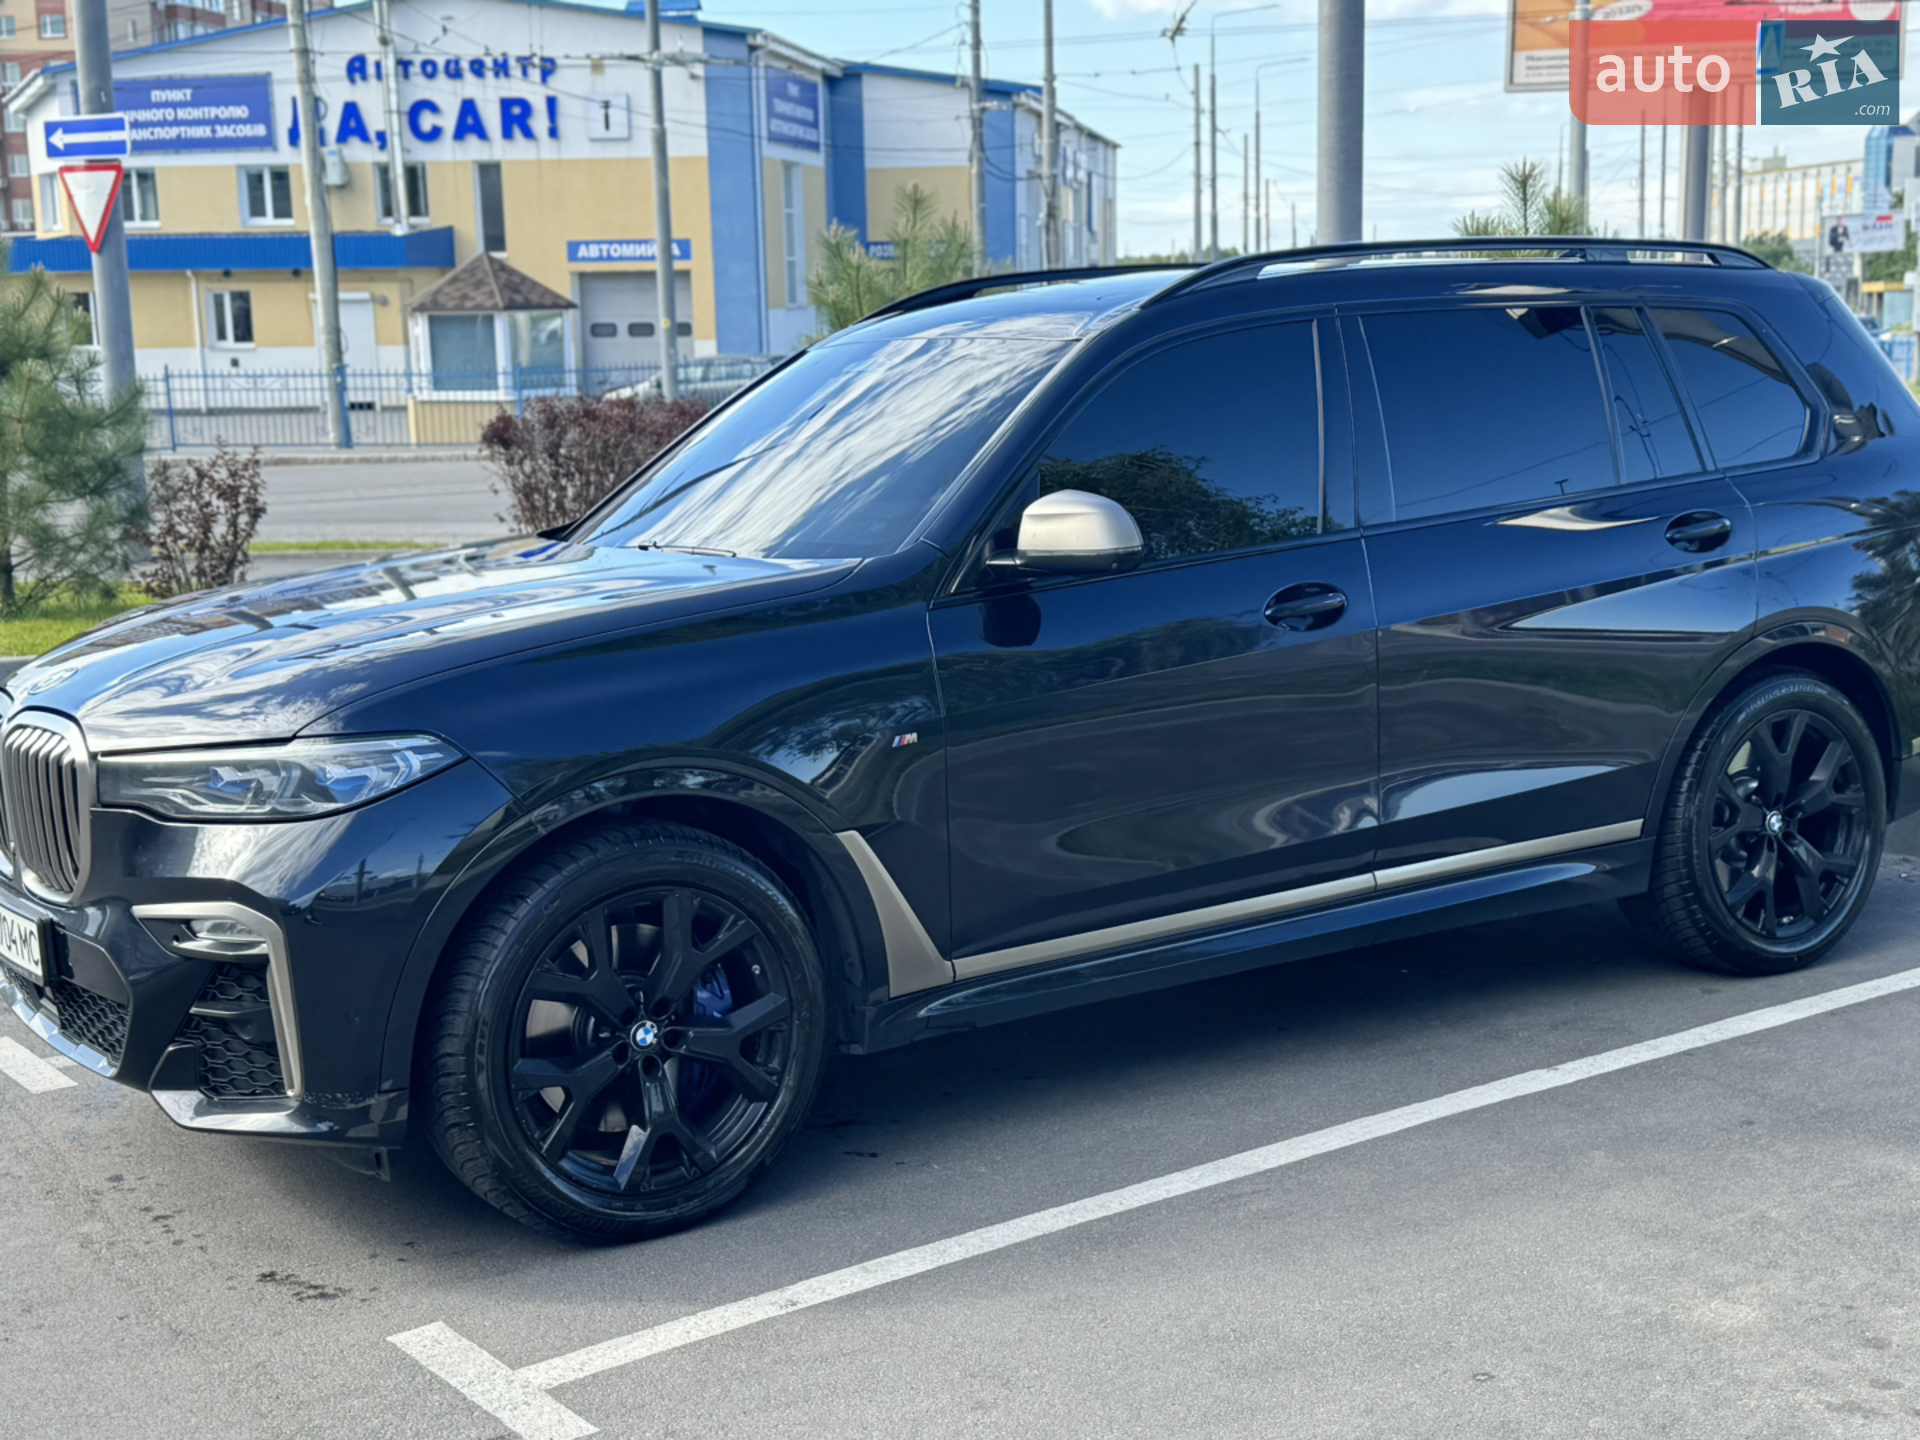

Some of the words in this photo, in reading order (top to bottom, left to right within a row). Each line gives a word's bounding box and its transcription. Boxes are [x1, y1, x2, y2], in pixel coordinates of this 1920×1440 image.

[151, 89, 193, 103] ПУНКТ
[177, 105, 249, 121] КОНТРОЛЮ
[408, 95, 559, 143] CAR!
[131, 126, 213, 141] АНСПОРТНИХ
[215, 124, 268, 138] ЗАСОБІВ
[577, 239, 681, 259] АВТОМИЙА
